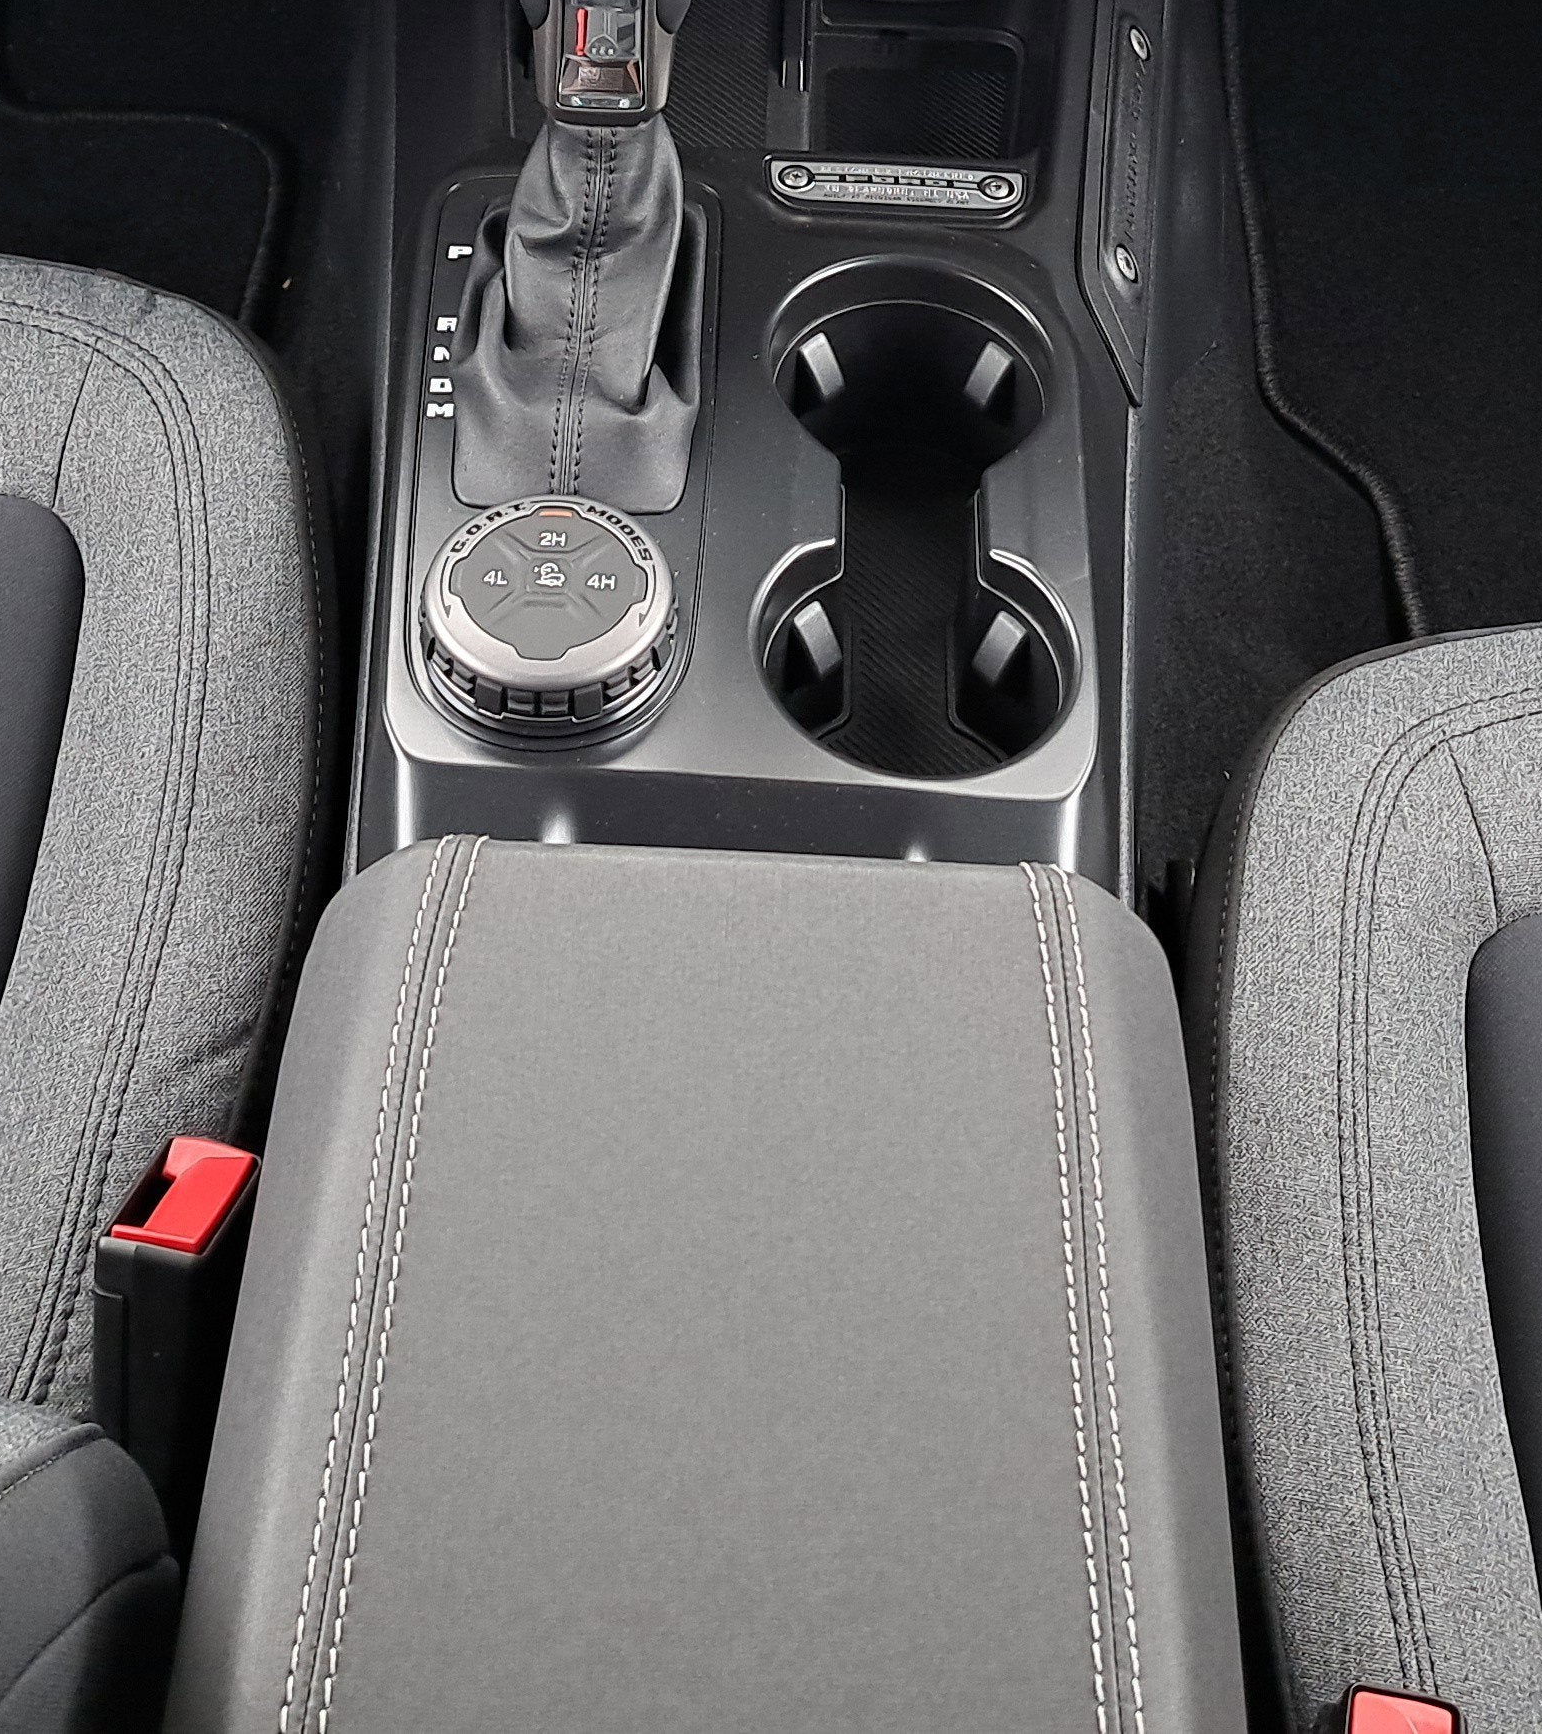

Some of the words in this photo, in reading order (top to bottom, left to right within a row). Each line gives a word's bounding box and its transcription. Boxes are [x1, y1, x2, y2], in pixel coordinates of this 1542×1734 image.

[448, 245, 473, 259] P
[436, 316, 458, 332] R
[429, 378, 453, 393] D
[426, 403, 455, 417] M
[539, 532, 567, 547] 2H
[586, 505, 653, 561] MODES
[483, 570, 508, 586] 4L
[586, 574, 616, 590] 4H
